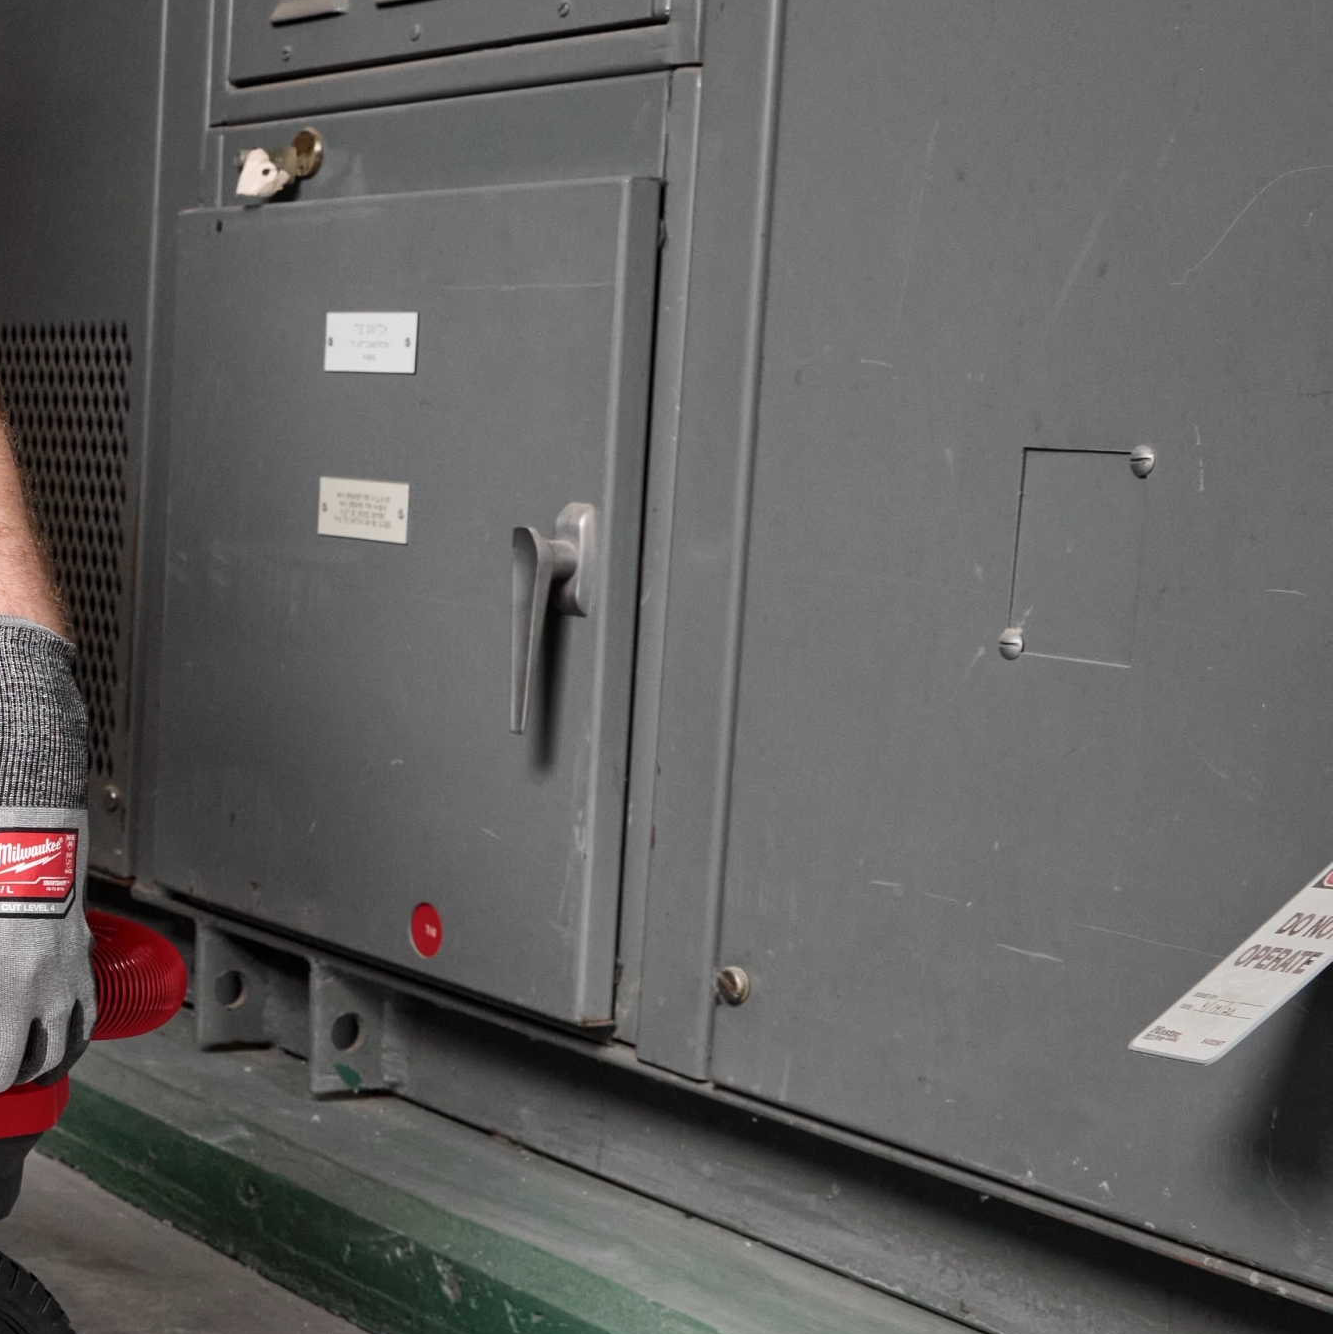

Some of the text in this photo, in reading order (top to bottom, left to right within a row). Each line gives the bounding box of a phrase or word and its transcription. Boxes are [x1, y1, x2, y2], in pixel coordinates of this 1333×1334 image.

[1, 903, 56, 912] CUT LEVEL 4
[1274, 912, 1316, 937] DO
[1233, 944, 1324, 975] OPERATE
